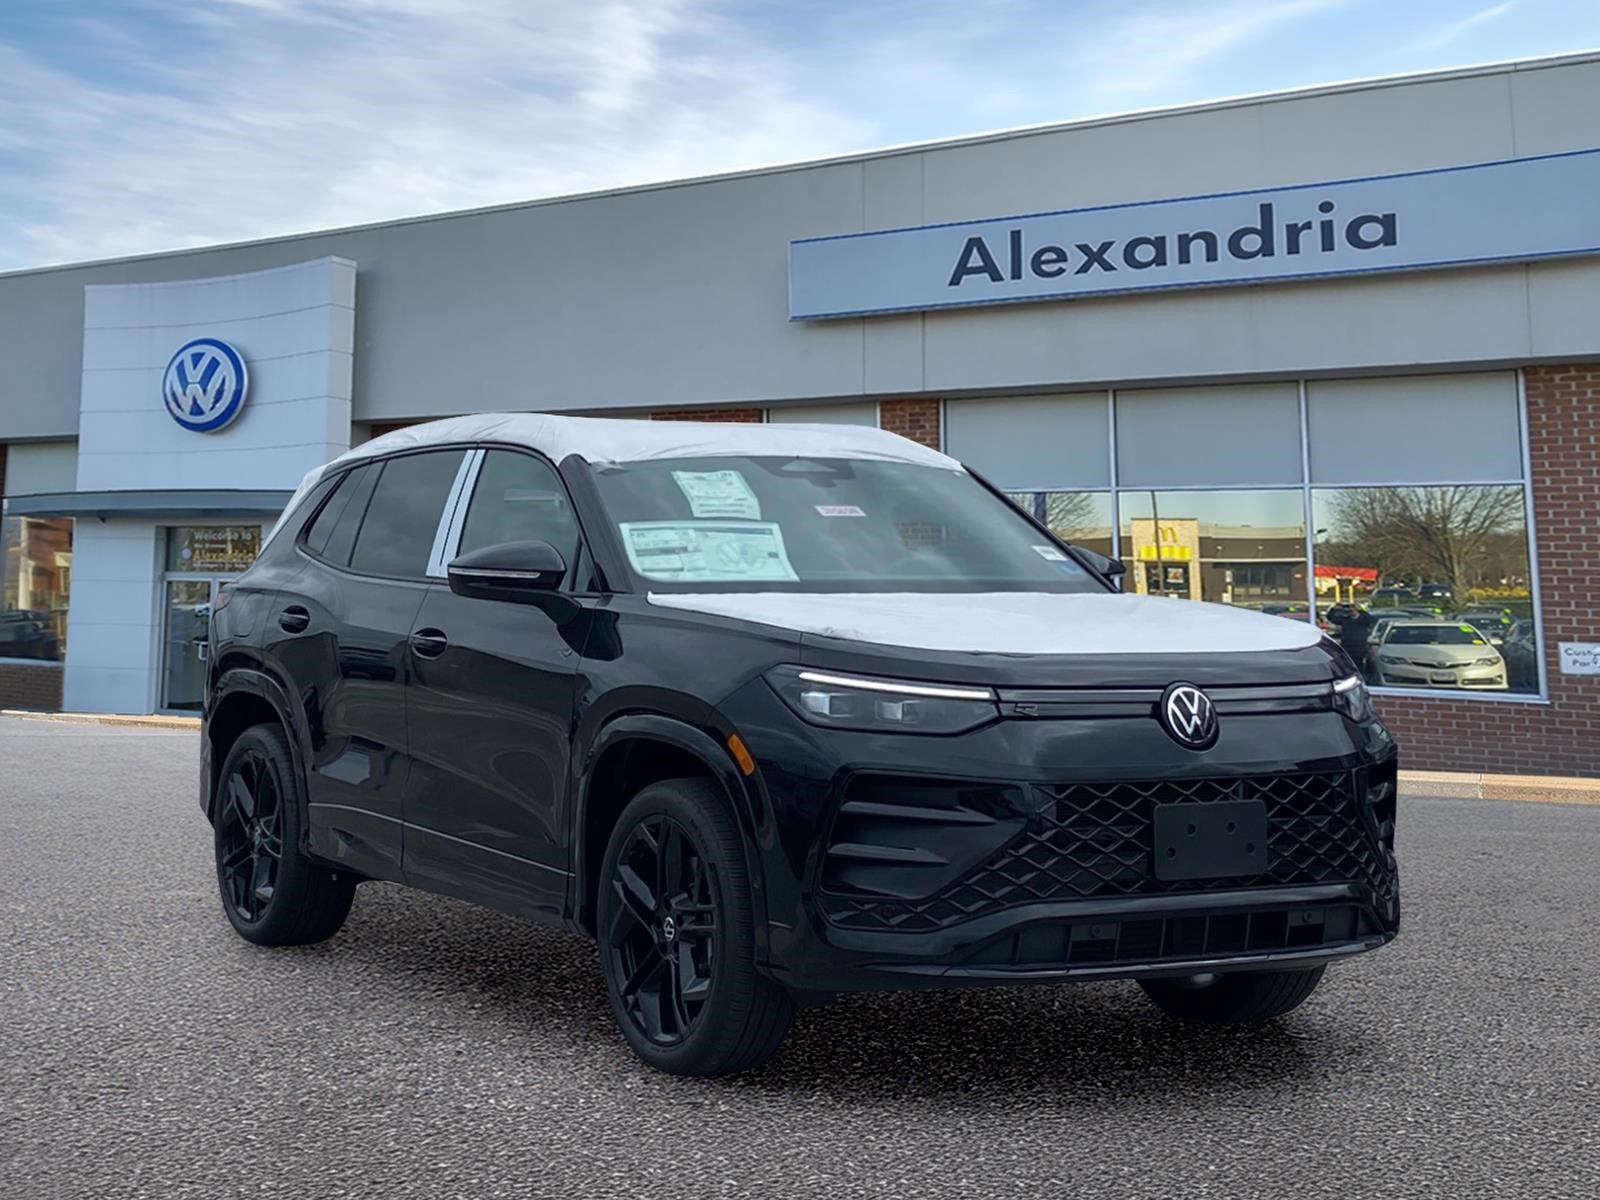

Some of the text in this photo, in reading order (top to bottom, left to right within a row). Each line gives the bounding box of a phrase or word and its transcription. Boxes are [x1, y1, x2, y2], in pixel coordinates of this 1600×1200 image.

[948, 201, 1397, 287] Alexandria
[164, 339, 244, 430] VW
[1166, 685, 1216, 744] VW
